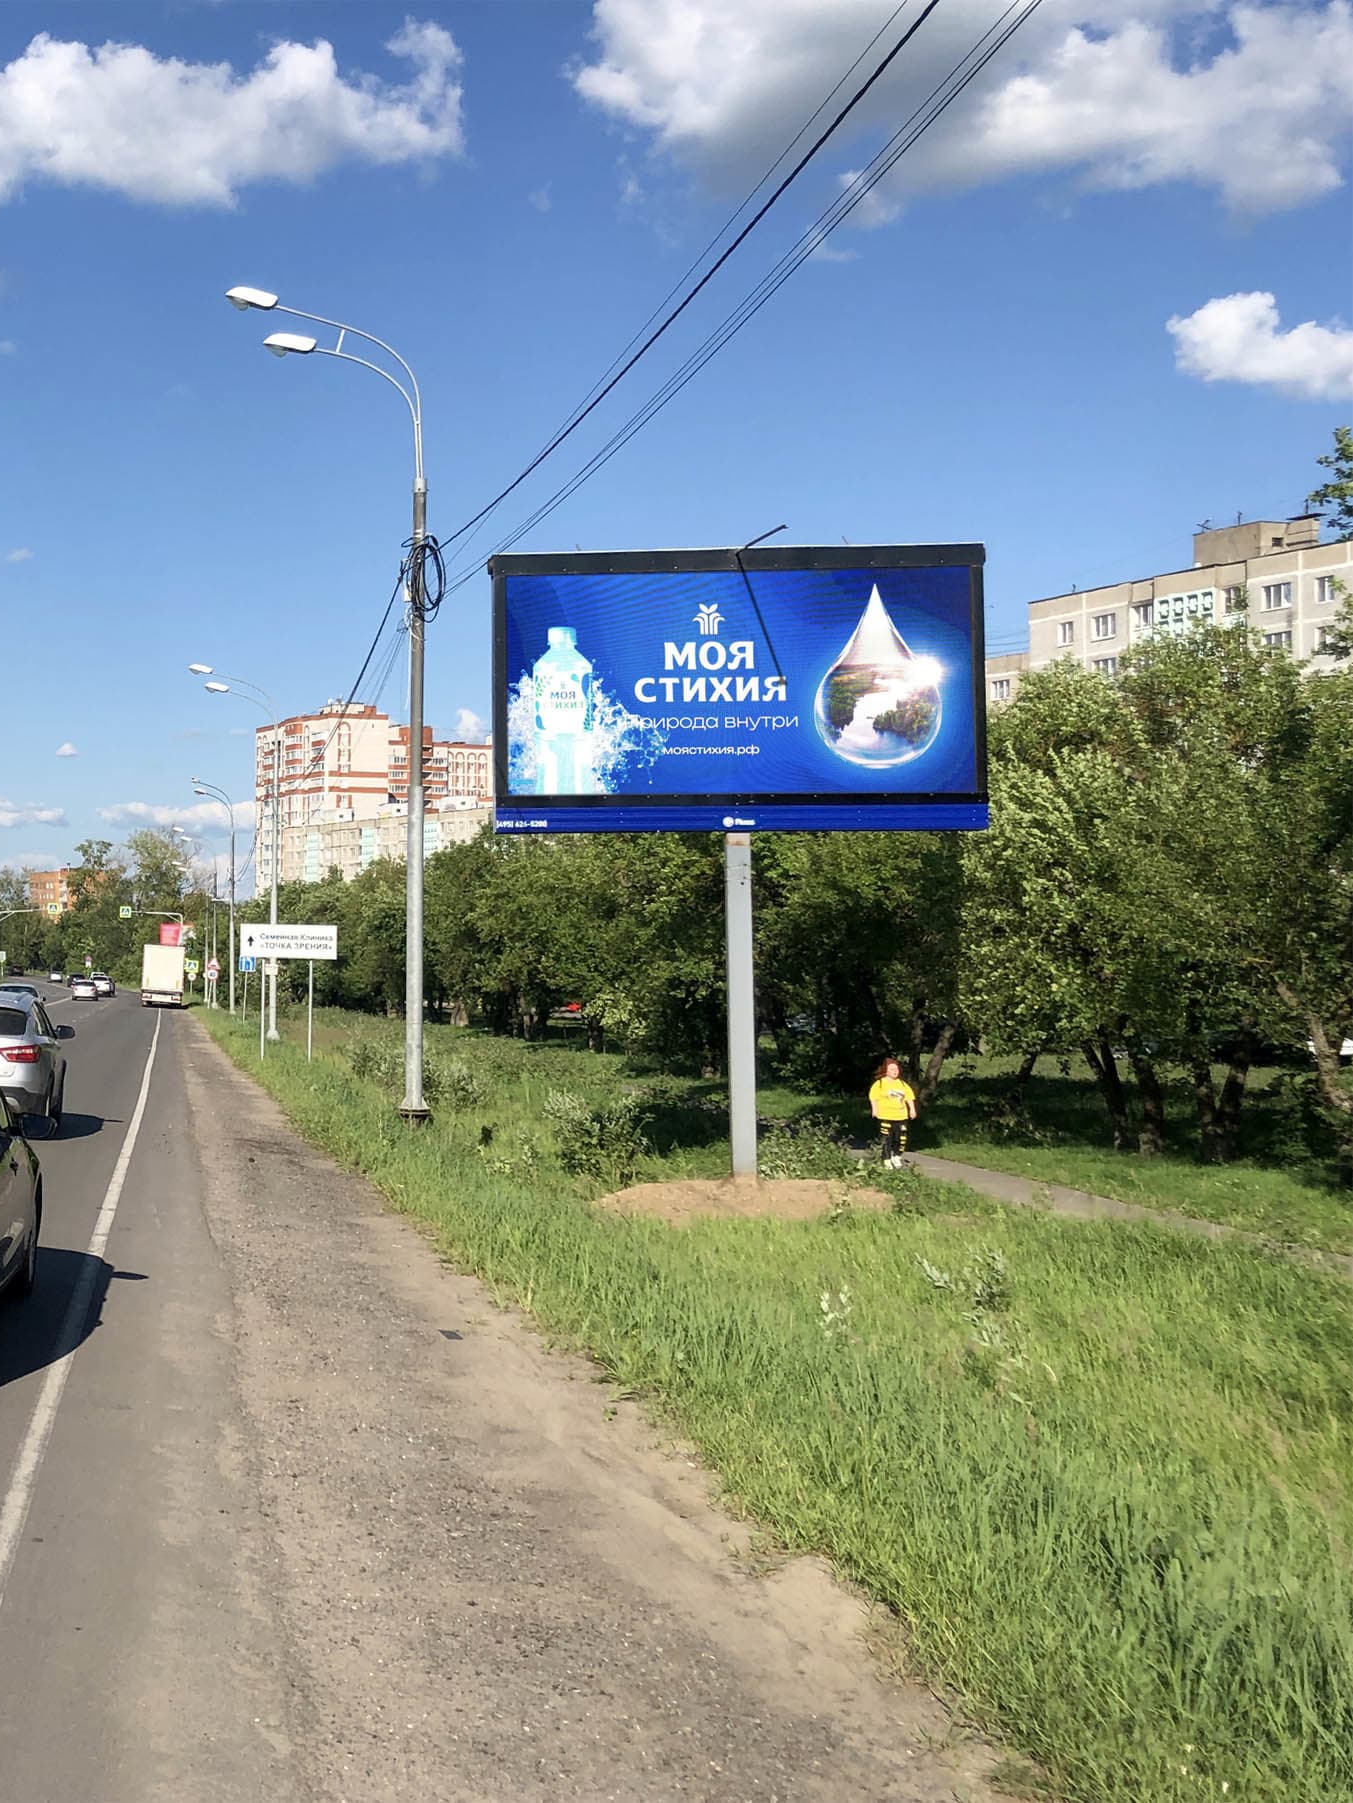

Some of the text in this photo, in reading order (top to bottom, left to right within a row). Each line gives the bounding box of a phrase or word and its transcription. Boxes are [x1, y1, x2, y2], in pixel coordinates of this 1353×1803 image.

[664, 641, 754, 670] МОЯ
[550, 691, 576, 699] МОЯ
[634, 676, 787, 702] СТИХИЯ
[543, 701, 584, 709] ИХИ
[724, 715, 799, 731] внутри
[663, 744, 760, 755] моястихия.рф
